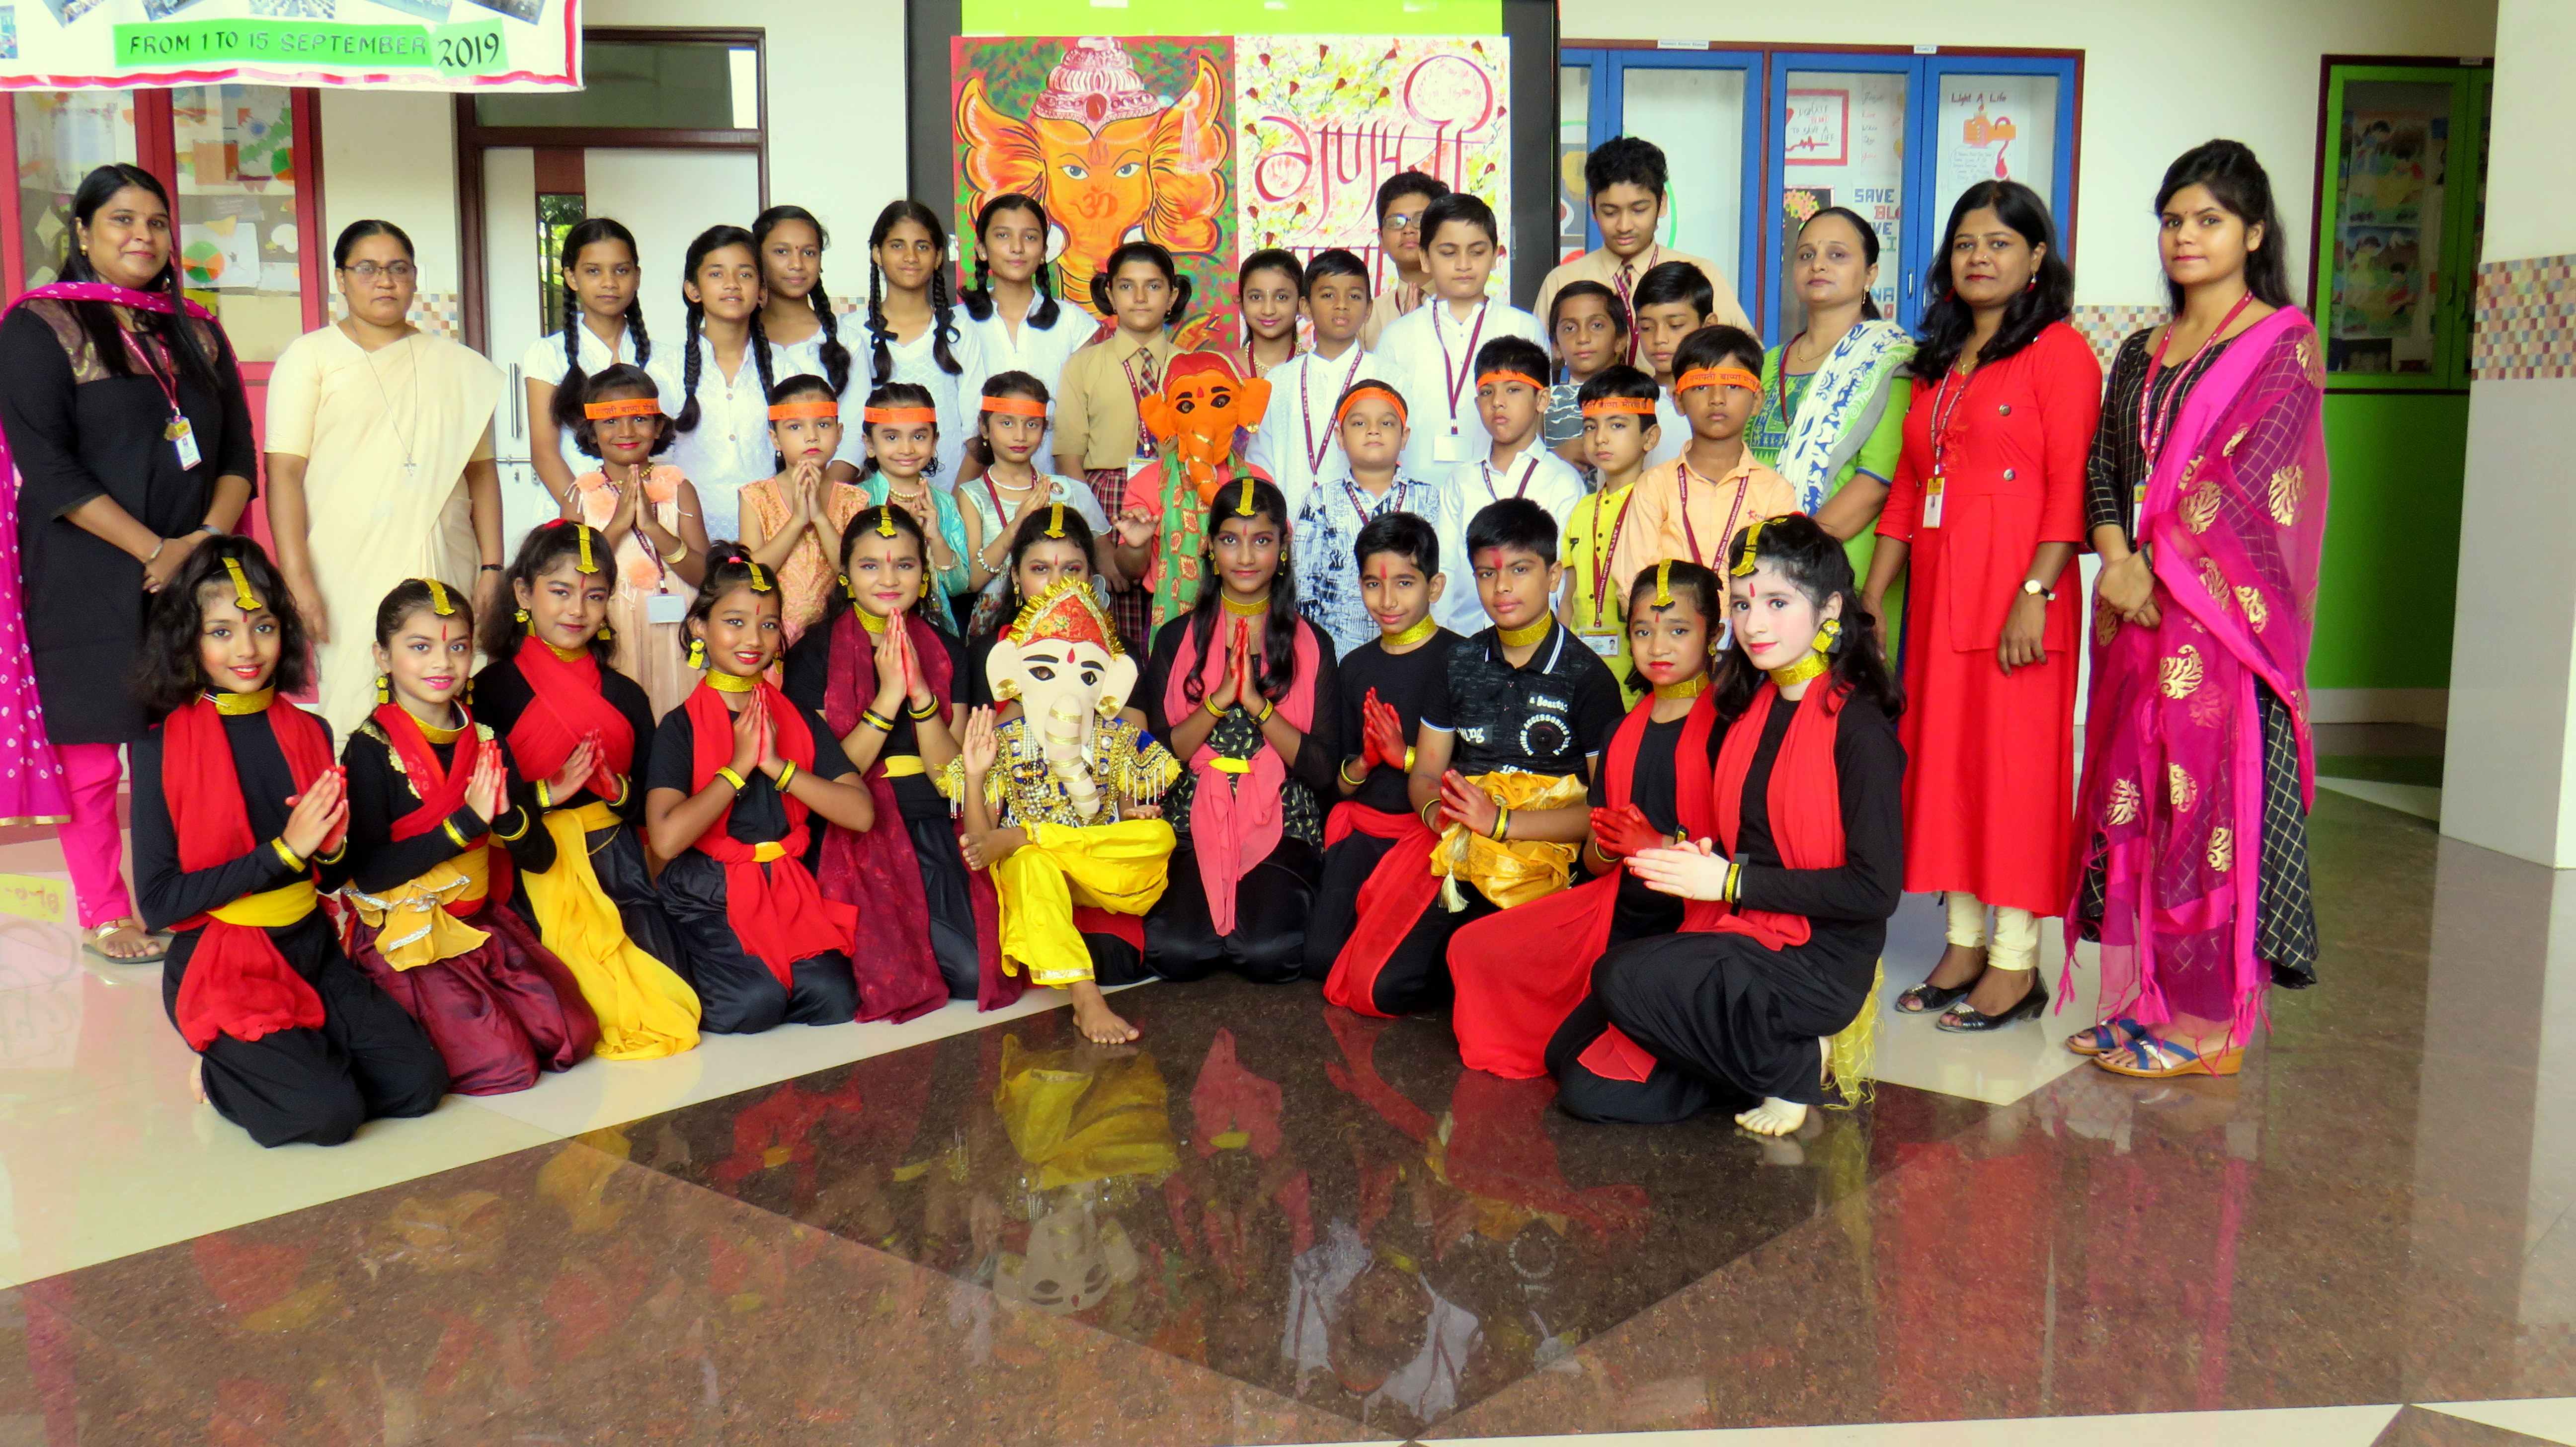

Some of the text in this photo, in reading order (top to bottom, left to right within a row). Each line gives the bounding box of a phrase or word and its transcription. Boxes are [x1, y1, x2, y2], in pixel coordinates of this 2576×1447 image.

[130, 34, 190, 54] FROM
[216, 31, 239, 49] TO
[249, 32, 269, 50] 15
[280, 33, 426, 55] SEPTEMBER
[437, 32, 499, 68] 2019
[1854, 188, 1894, 203] SAVE
[1718, 541, 1727, 559] John
[1724, 497, 1742, 541] International
[1524, 714, 1570, 736] ACCESSORIES
